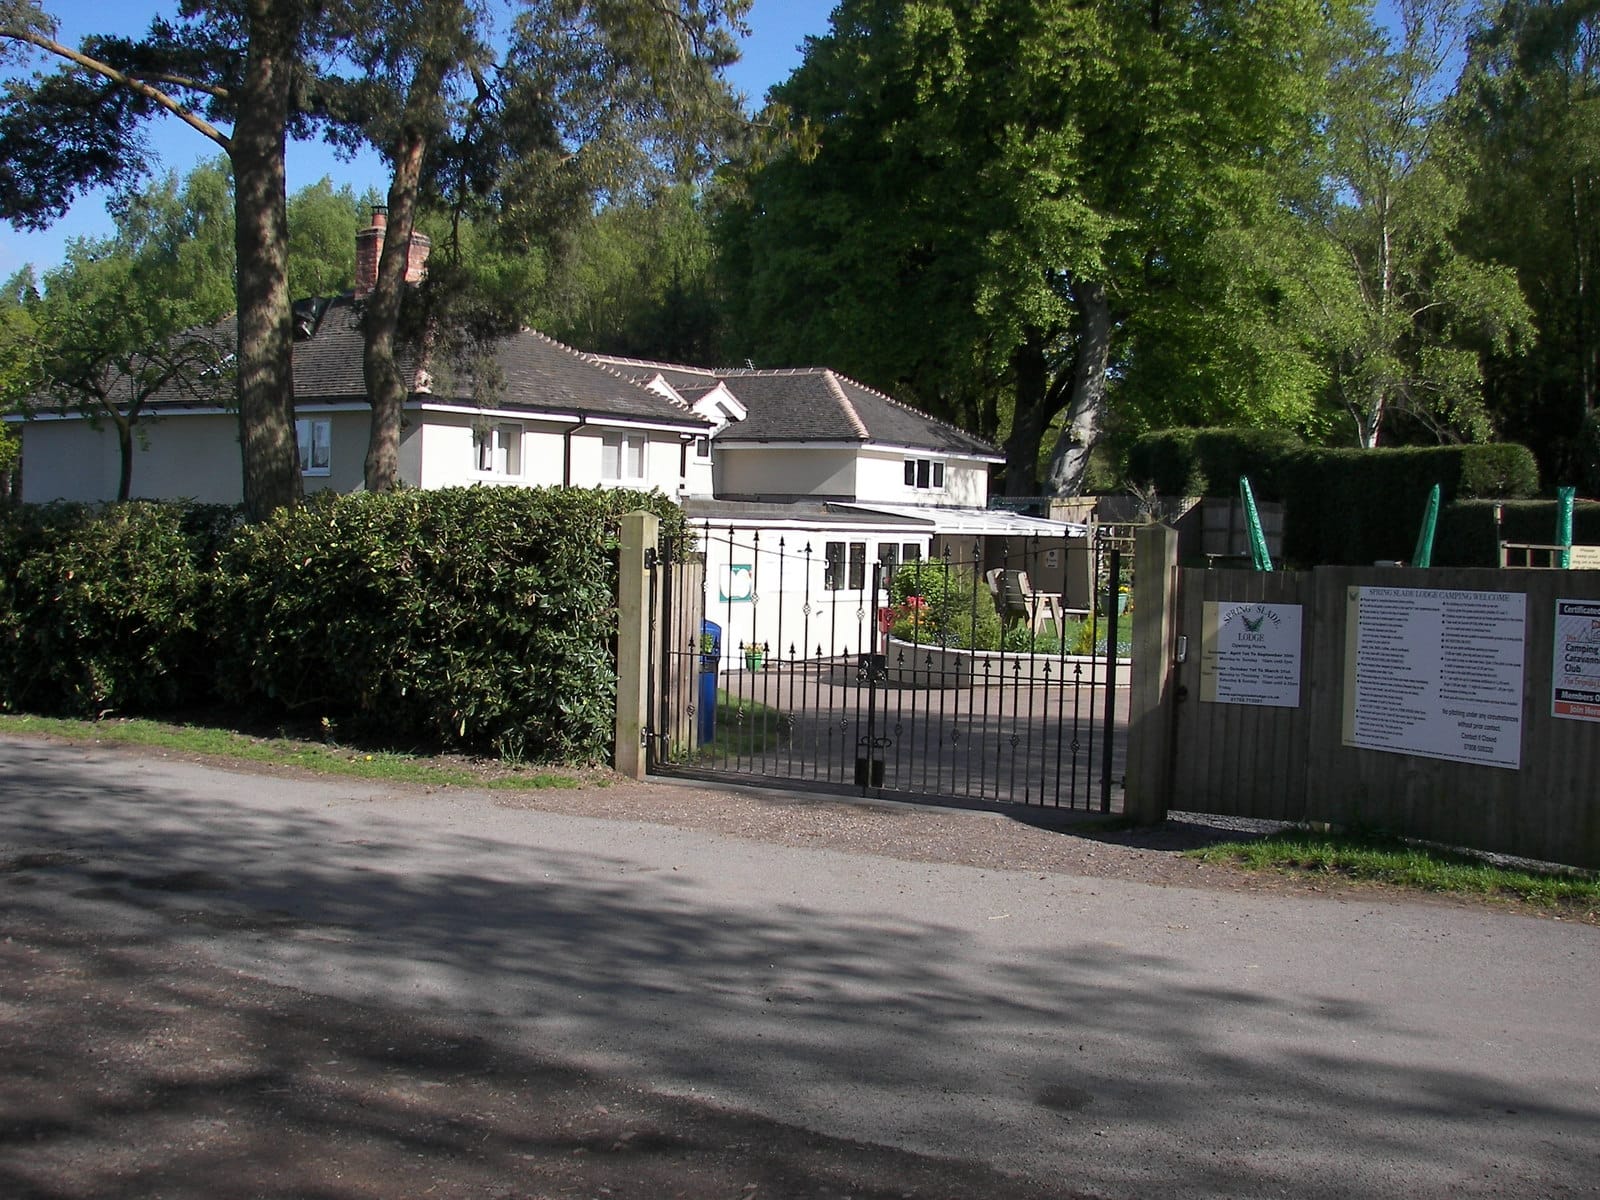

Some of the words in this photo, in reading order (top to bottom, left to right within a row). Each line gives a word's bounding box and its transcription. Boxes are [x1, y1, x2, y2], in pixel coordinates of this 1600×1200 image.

[1439, 592, 1472, 600] CAMPING
[1473, 593, 1510, 601] WELCOME
[1223, 605, 1251, 625] SPRING
[1256, 605, 1281, 625] SLADE
[1238, 632, 1265, 641] LODGE
[1565, 643, 1599, 655] Camping
[1564, 663, 1581, 672] Club
[1561, 690, 1594, 701] Members
[1569, 704, 1584, 713] Join
